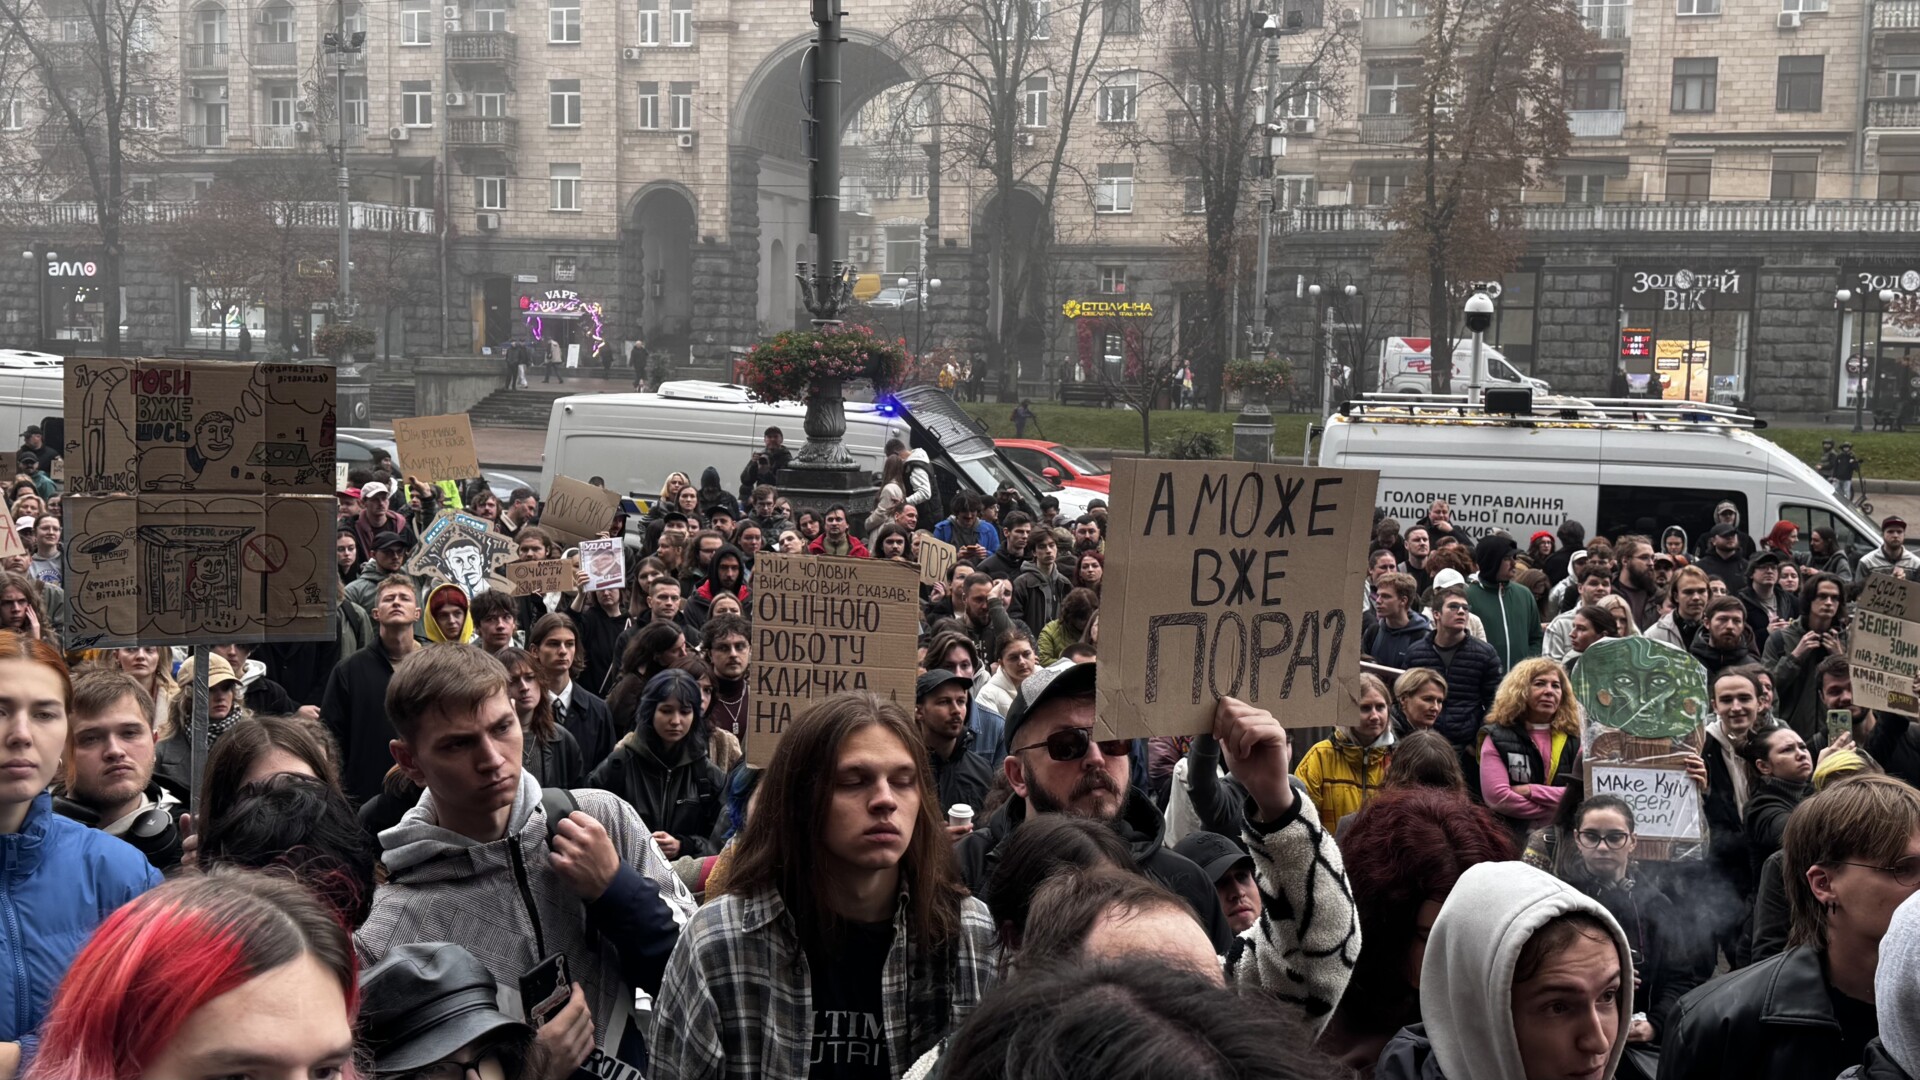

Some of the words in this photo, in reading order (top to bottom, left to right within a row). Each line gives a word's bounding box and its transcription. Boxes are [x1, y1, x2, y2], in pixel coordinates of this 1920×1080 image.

[48, 261, 97, 276] алло
[545, 290, 578, 299] VAPE
[1081, 301, 1153, 312] СТОЛИЧНА
[1663, 290, 1707, 311] ВІК
[74, 364, 89, 388] Я
[130, 368, 191, 395] РОБИ
[137, 395, 193, 422] ВЖЕ
[1143, 472, 1175, 536] А
[1188, 472, 1343, 538] МОЖЕ
[1384, 490, 1457, 505] ГОЛОВНЕ
[1461, 494, 1564, 511] УПРАВЛІННЯ
[1381, 506, 1499, 524] НАЦІОЛЬНОЇ
[585, 542, 612, 551] УДАР
[760, 558, 790, 575] МІЙ
[799, 563, 858, 580] ЧОЛОВІК
[1190, 548, 1289, 607] ВЖЕ
[759, 575, 850, 595] ВІЙСЬКОВИЙ
[857, 584, 911, 602] СКАЗАВ:
[758, 592, 880, 632] ОЦІНЮЮ
[1858, 611, 1902, 638] ЗЕЛЕНІ
[758, 629, 866, 665] РОБОТУ
[1144, 608, 1346, 704] ПОРА?
[1890, 638, 1918, 659] ЗОНИ
[757, 666, 868, 698] КЛИЧКА
